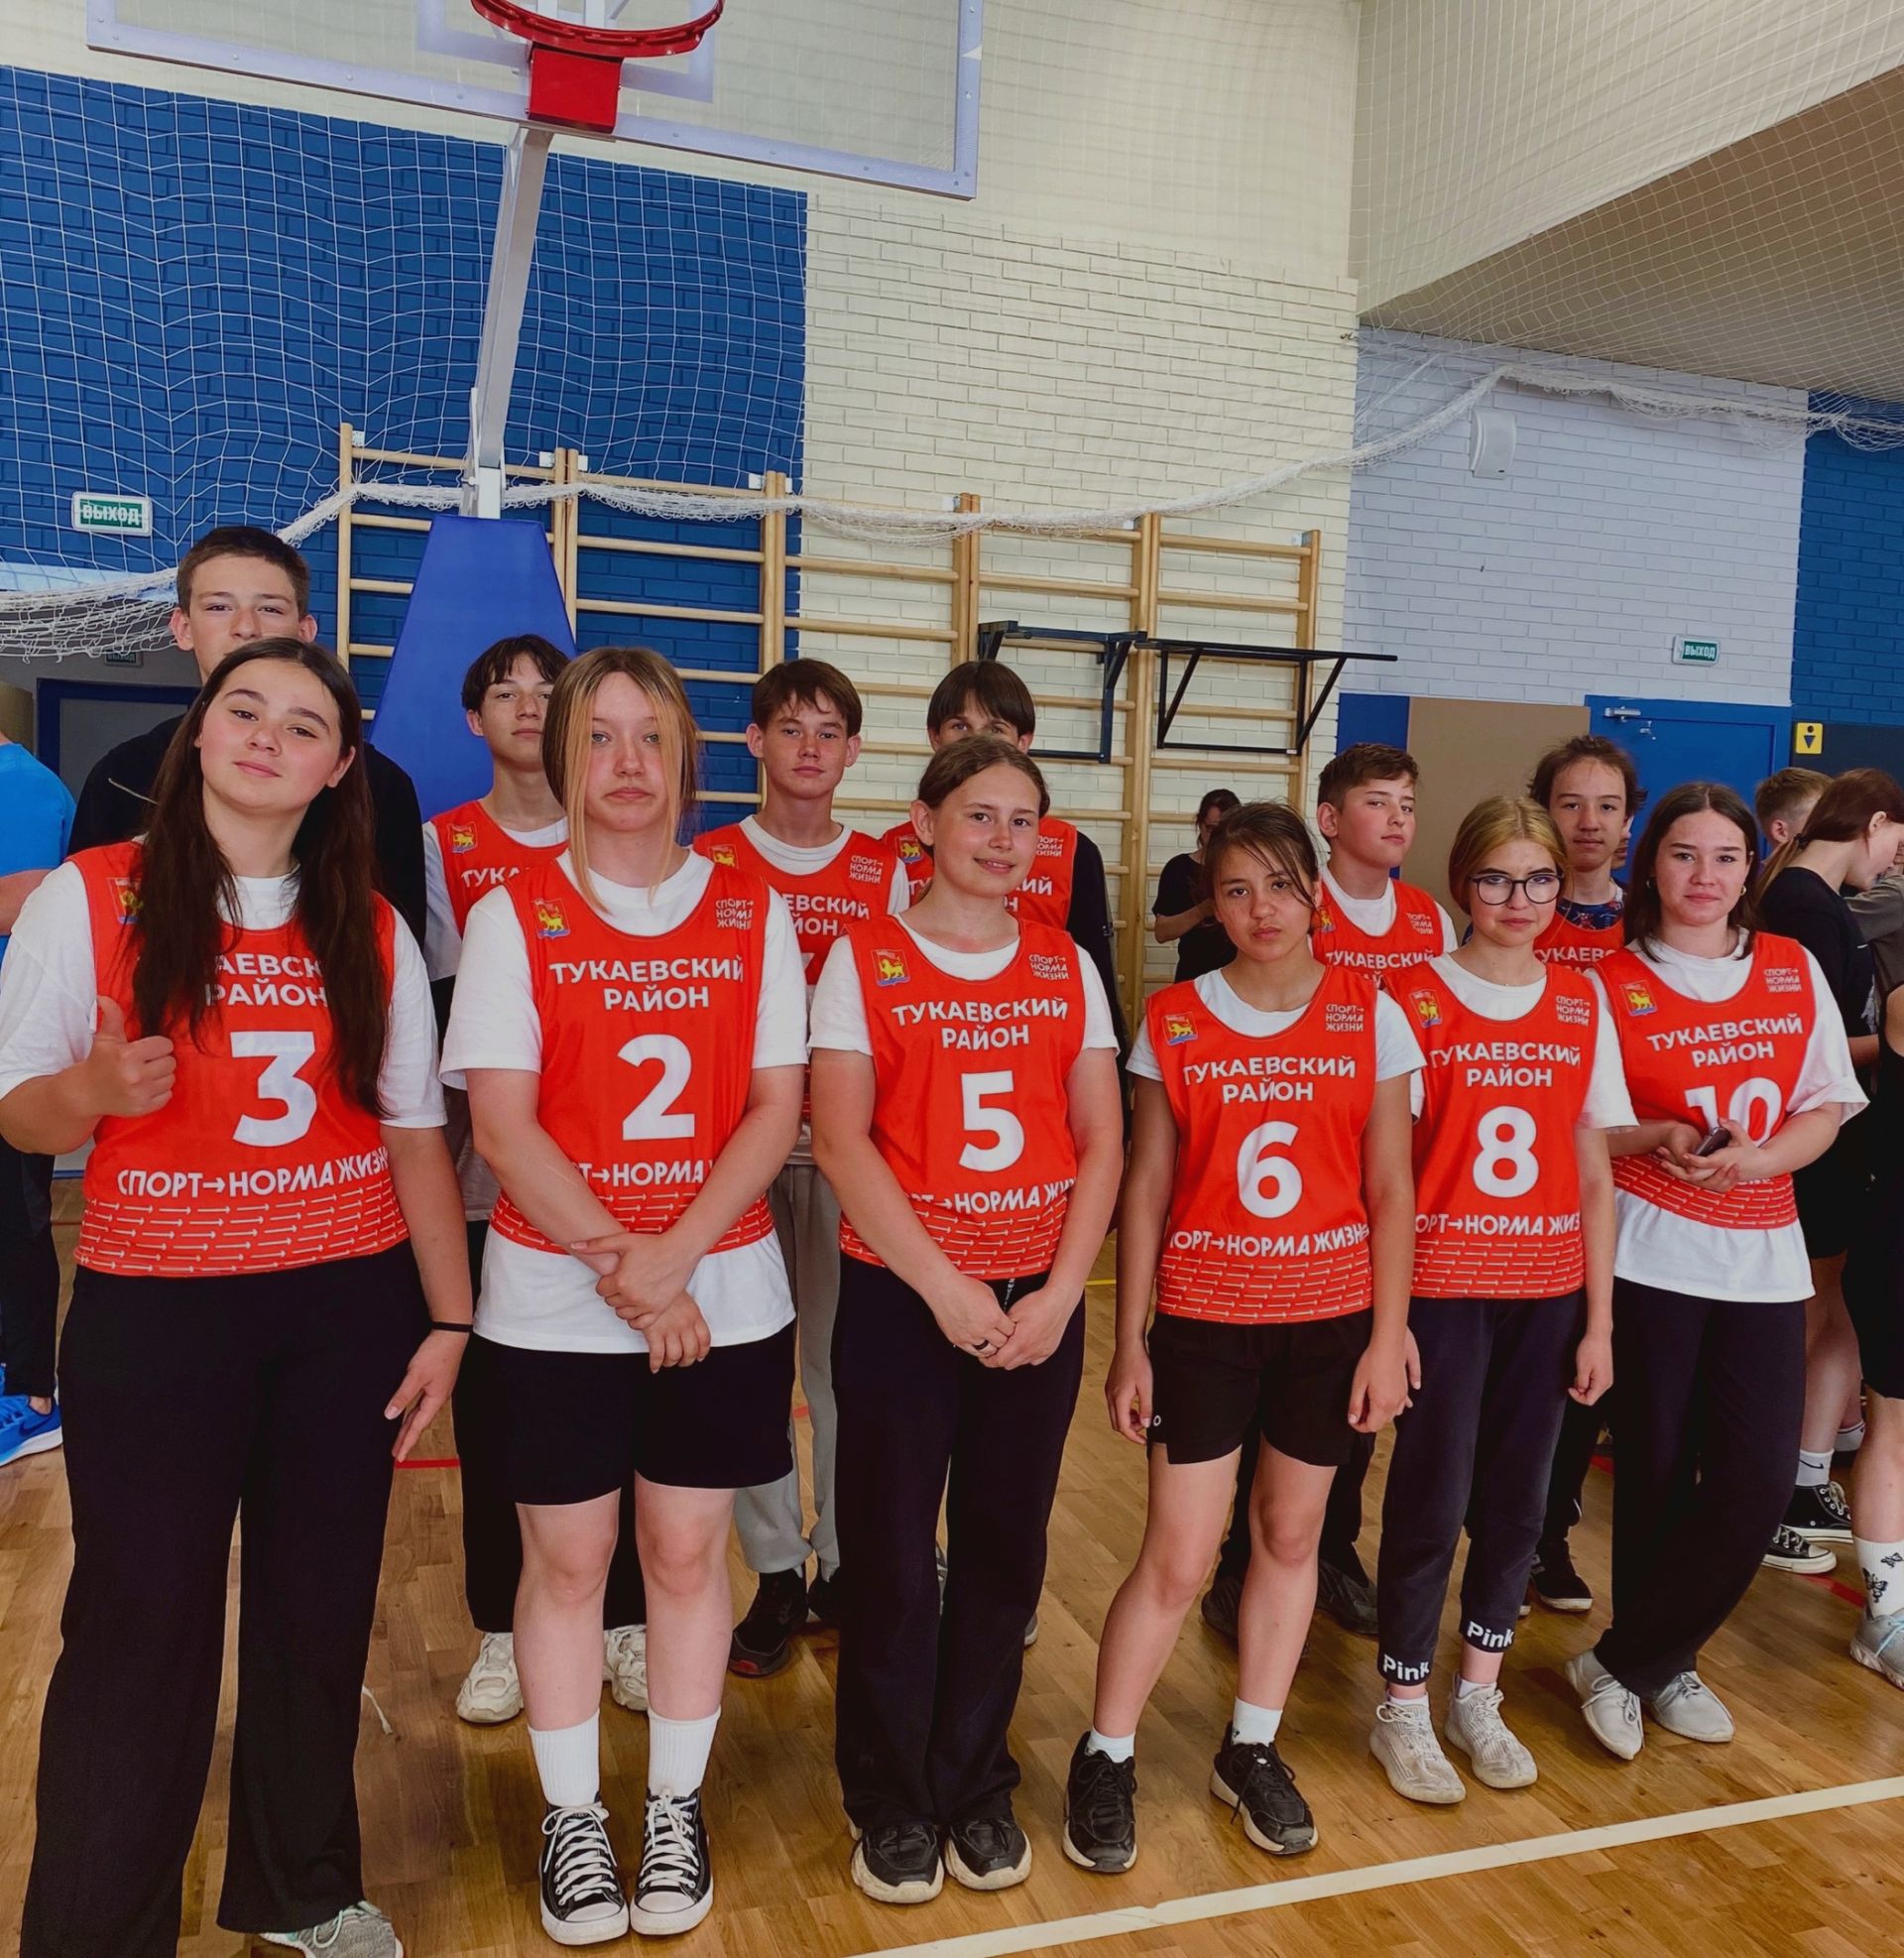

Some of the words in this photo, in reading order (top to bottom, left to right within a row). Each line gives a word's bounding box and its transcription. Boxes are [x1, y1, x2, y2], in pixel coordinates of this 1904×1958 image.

[82, 504, 140, 526] ВЫХОД
[1685, 645, 1716, 660] ВЫХОД
[850, 863, 883, 875] НОРМА
[851, 855, 878, 866] СПОРТ
[849, 872, 881, 884] ЖИЗНИ
[715, 898, 747, 910] СПОРТ
[548, 954, 744, 985] ТУКАЕВСКИЙ
[1028, 953, 1059, 965] СПОРТ
[1030, 962, 1068, 973] НОРМА
[603, 984, 710, 1013] РАЙОН
[891, 996, 1069, 1027] ТУКАЕВСКИЙ
[1325, 1003, 1358, 1014] СПОРТ
[1556, 995, 1584, 1007] СПОРТ
[1556, 1004, 1591, 1018] НОРМА
[1325, 1012, 1365, 1023] НОРМА
[1325, 1022, 1365, 1033] ЖИЗНИ
[941, 1023, 1030, 1051] РАЙОН
[1647, 1013, 1803, 1052] ТУКАЕВСКИЙ
[1691, 1040, 1775, 1069] РАЙОН
[617, 1034, 695, 1141] 2
[1466, 1063, 1553, 1088] РАЙОН
[230, 1031, 317, 1148] 3
[1222, 1077, 1314, 1104] РАЙОН
[958, 1070, 1025, 1172] 5
[1685, 1077, 1782, 1148] 10
[1472, 1105, 1540, 1198] 8
[117, 1169, 203, 1198] СПОРТ
[228, 1161, 334, 1197] НОРМА
[335, 1146, 389, 1184] ЖИЗН
[612, 1159, 705, 1187] НОРМА
[1237, 1121, 1303, 1219] 6
[953, 1185, 1041, 1215] НОРМА
[1465, 1213, 1543, 1237] НОРМА
[1226, 1234, 1311, 1258] НОРМА
[1467, 1620, 1514, 1649] Pink
[1382, 1653, 1430, 1681] Pink
